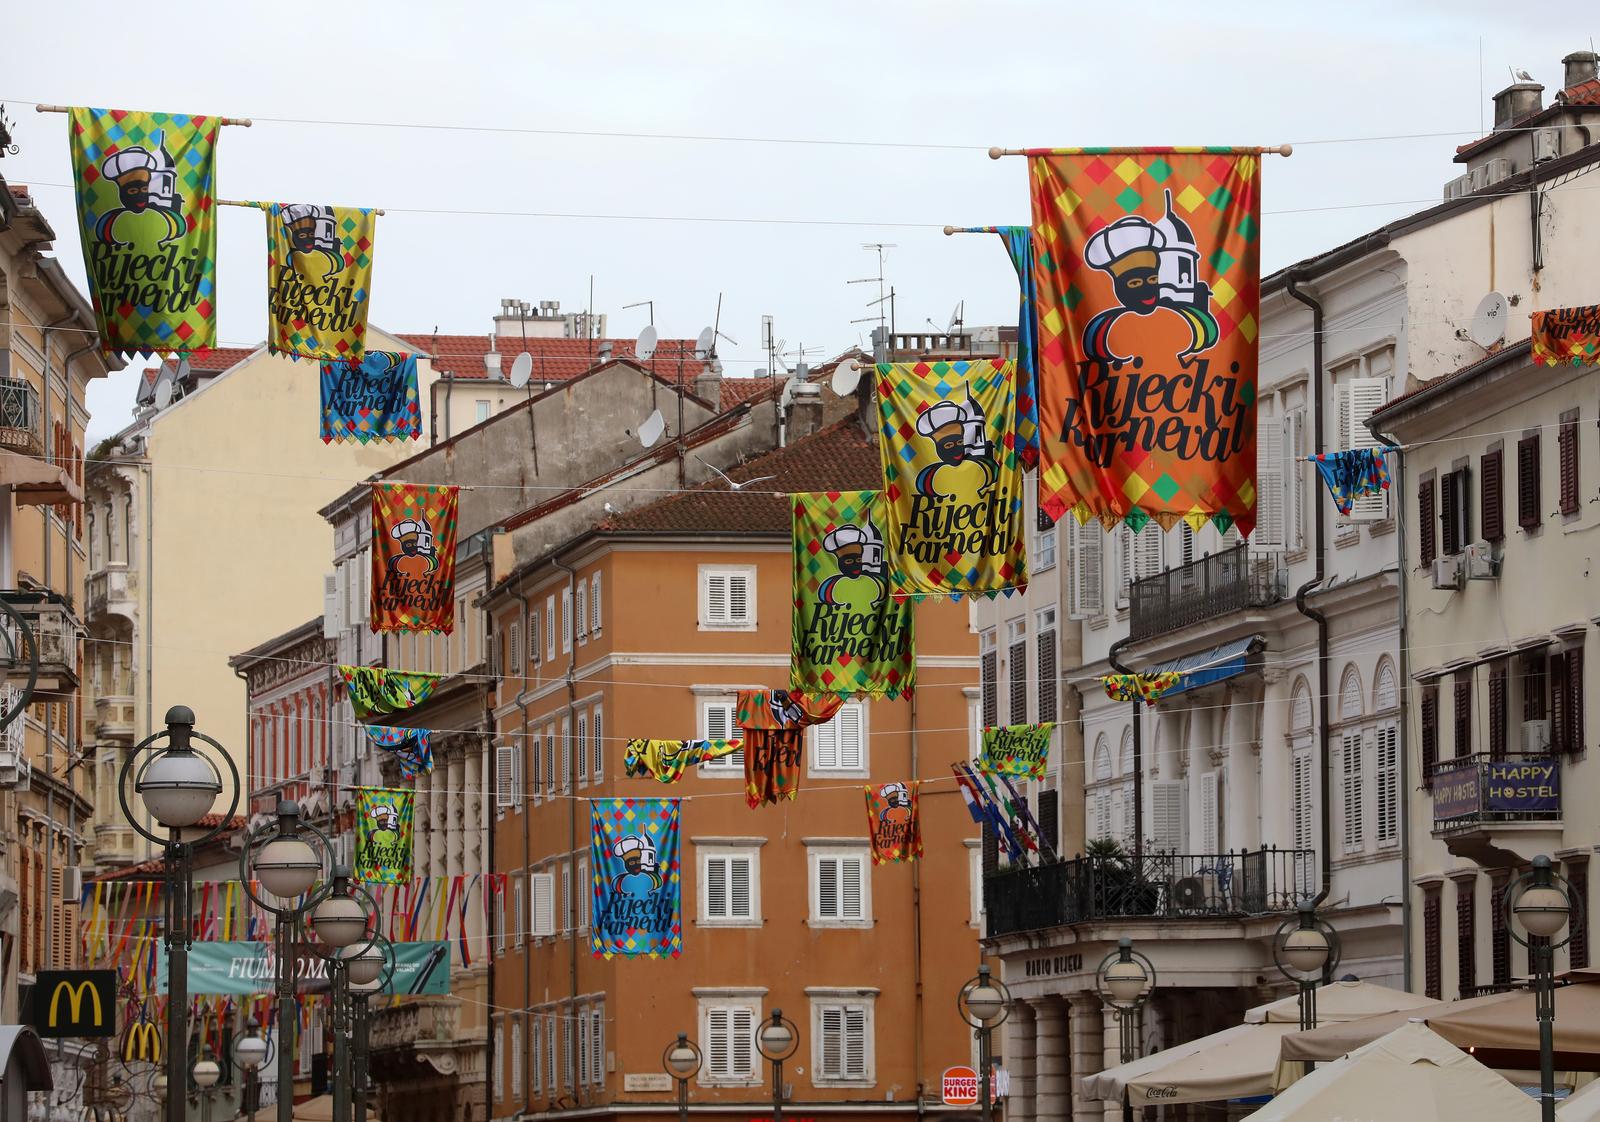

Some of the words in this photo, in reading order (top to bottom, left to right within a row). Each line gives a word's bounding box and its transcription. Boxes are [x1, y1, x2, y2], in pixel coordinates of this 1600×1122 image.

[1074, 356, 1240, 430] Riječki
[1059, 398, 1247, 469] karneval
[899, 513, 1015, 564] karneval
[801, 627, 905, 665] karneval
[987, 742, 1043, 762] karneval
[1492, 766, 1554, 780] HAPPY
[1434, 784, 1452, 804] HAPPY
[598, 907, 674, 935] karneval
[1026, 958, 1051, 976] RADIO
[1054, 953, 1083, 974] RIJEKA
[944, 1087, 976, 1097] KING
